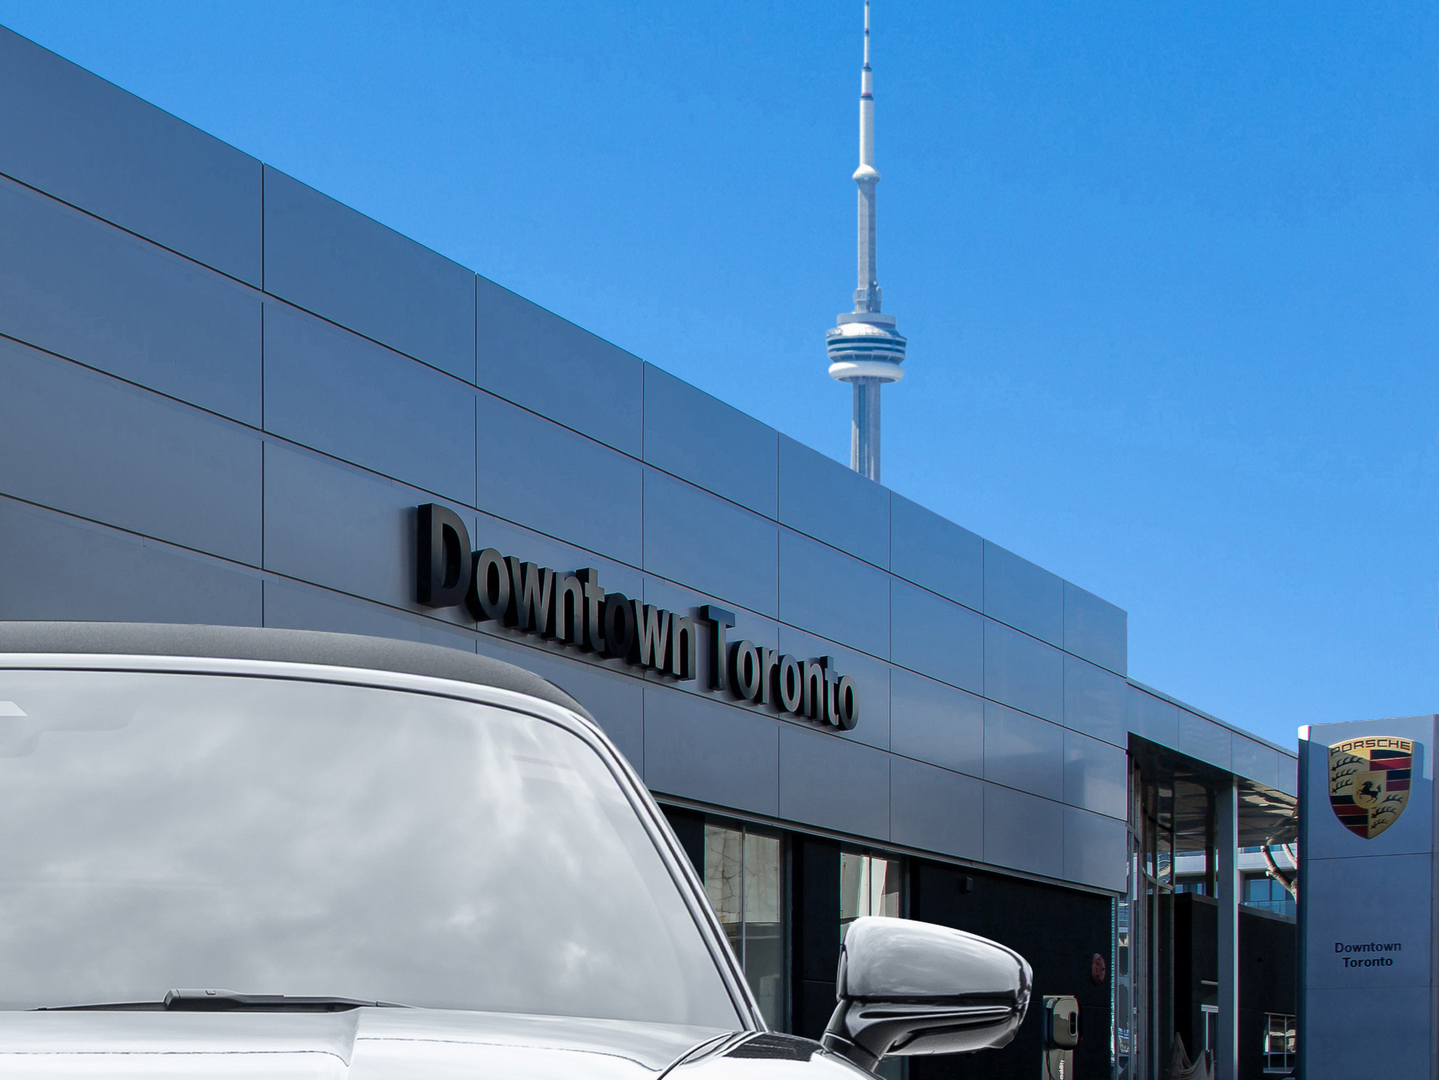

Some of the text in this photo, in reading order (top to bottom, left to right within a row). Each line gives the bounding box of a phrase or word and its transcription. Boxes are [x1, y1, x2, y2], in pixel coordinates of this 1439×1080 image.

[417, 502, 860, 731] Downtown Toronto
[1330, 739, 1411, 757] PORSCHE
[1334, 941, 1402, 954] Downtown
[1342, 956, 1393, 967] Toronto
